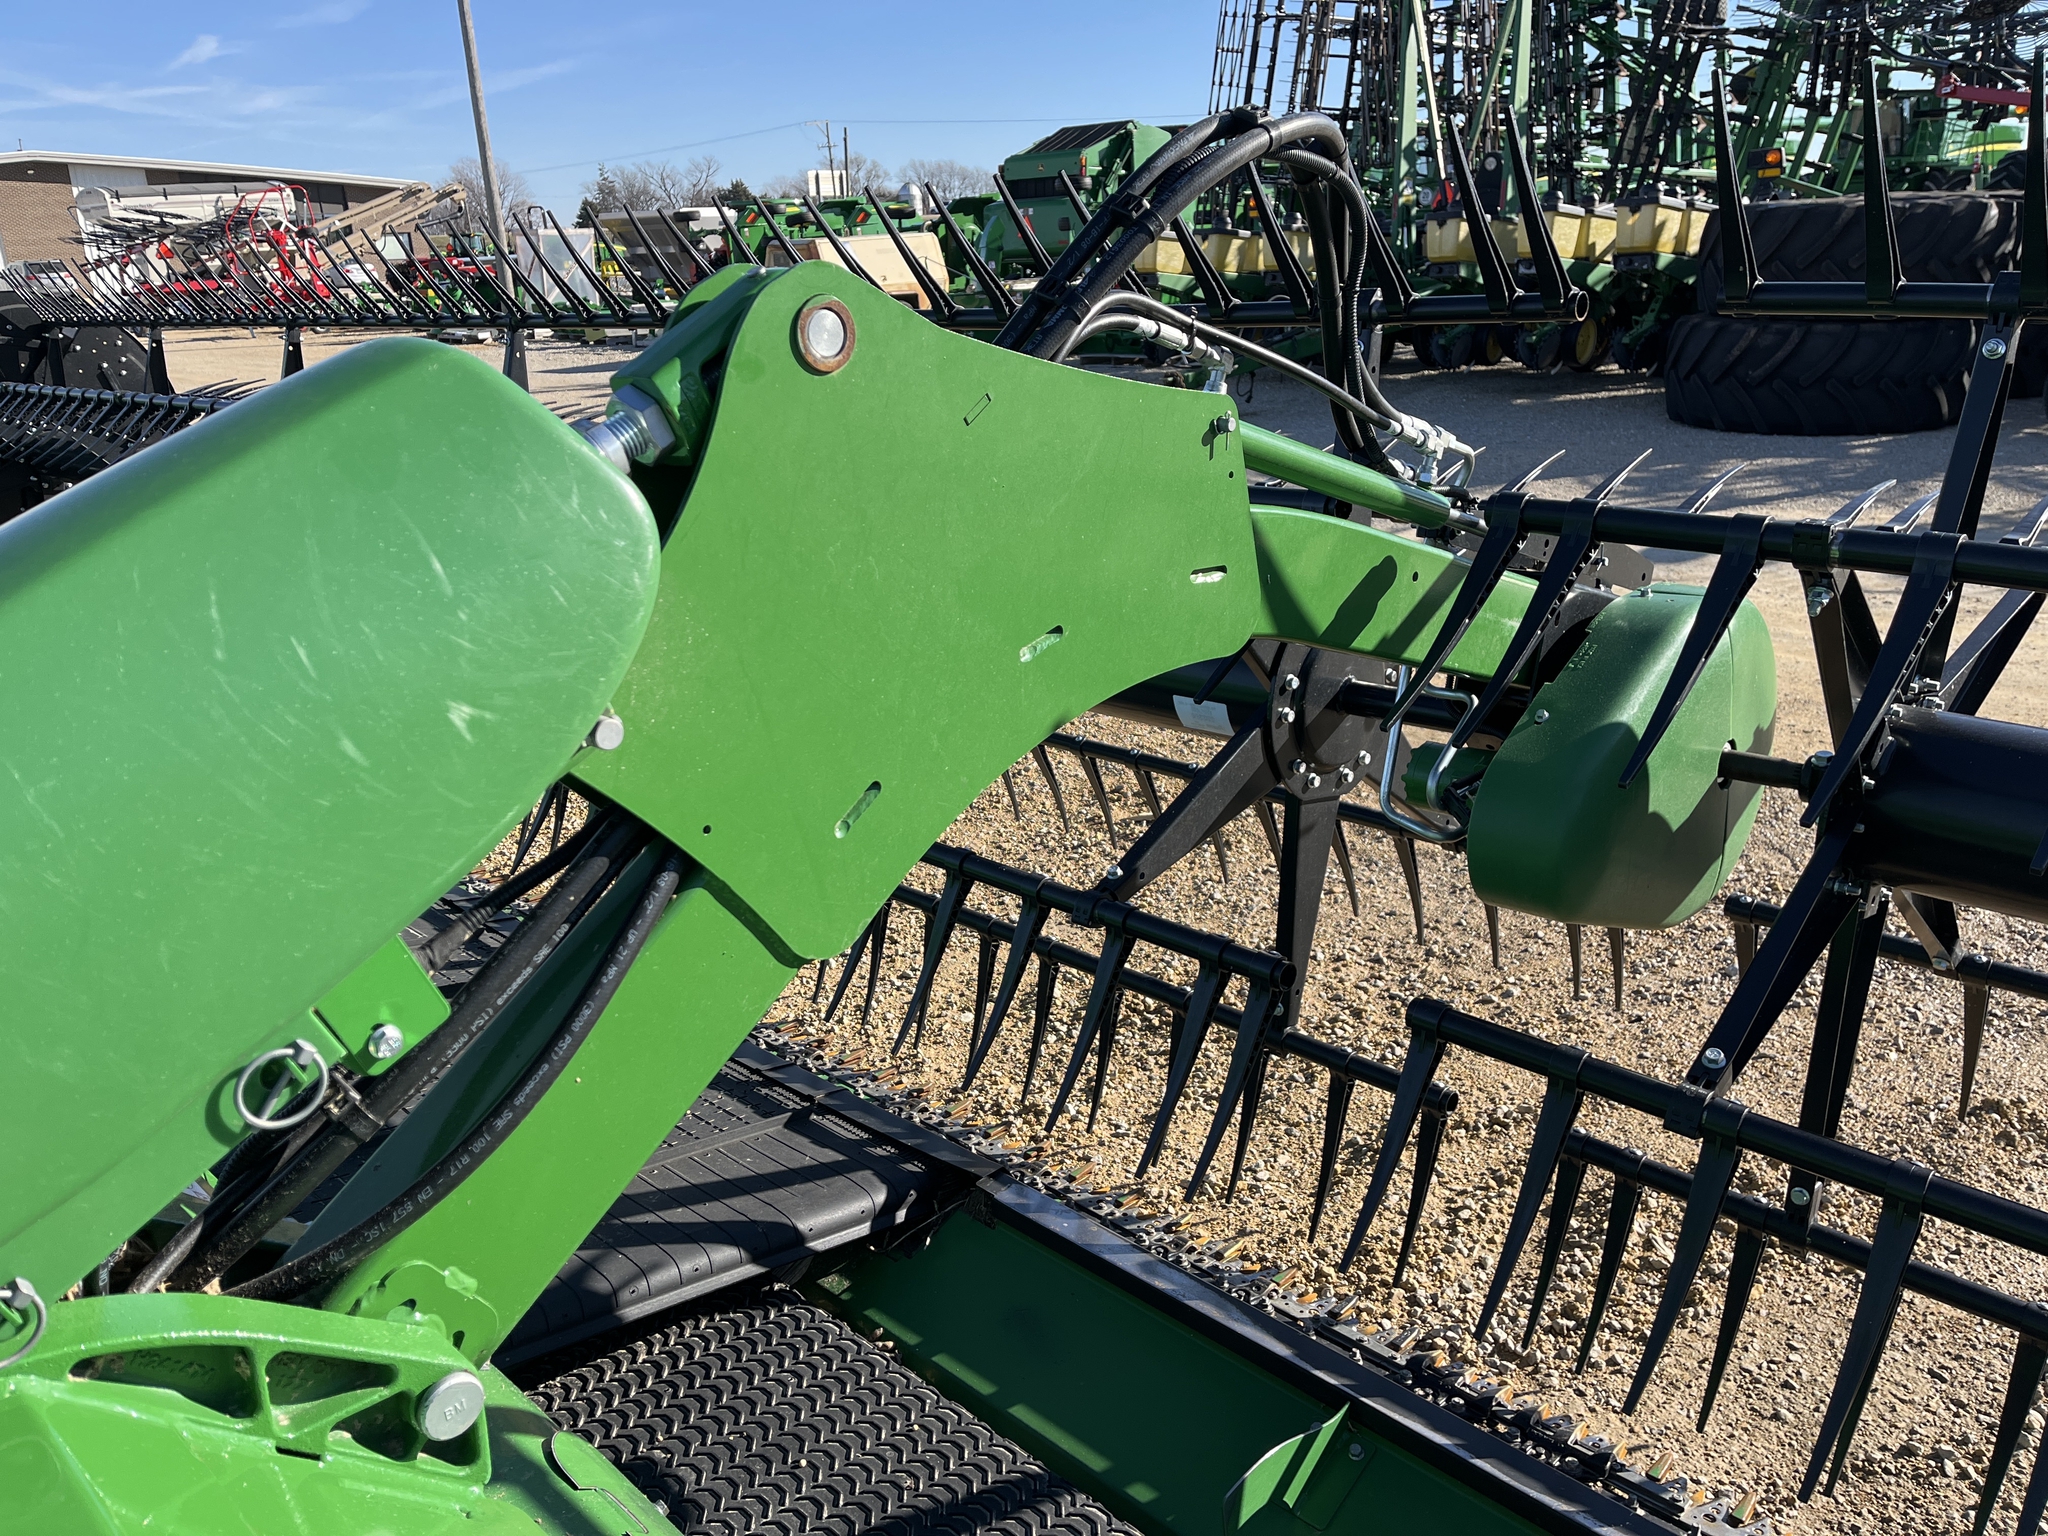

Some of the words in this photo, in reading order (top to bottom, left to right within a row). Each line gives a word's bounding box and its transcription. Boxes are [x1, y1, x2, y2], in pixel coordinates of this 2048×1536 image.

[496, 966, 533, 1005] exceeds
[513, 1063, 550, 1106] exceeds
[471, 1131, 491, 1153] 100
[449, 1154, 470, 1176] R17
[417, 1186, 434, 1203] EN
[392, 1200, 414, 1223] 857
[443, 1397, 470, 1423] BM
